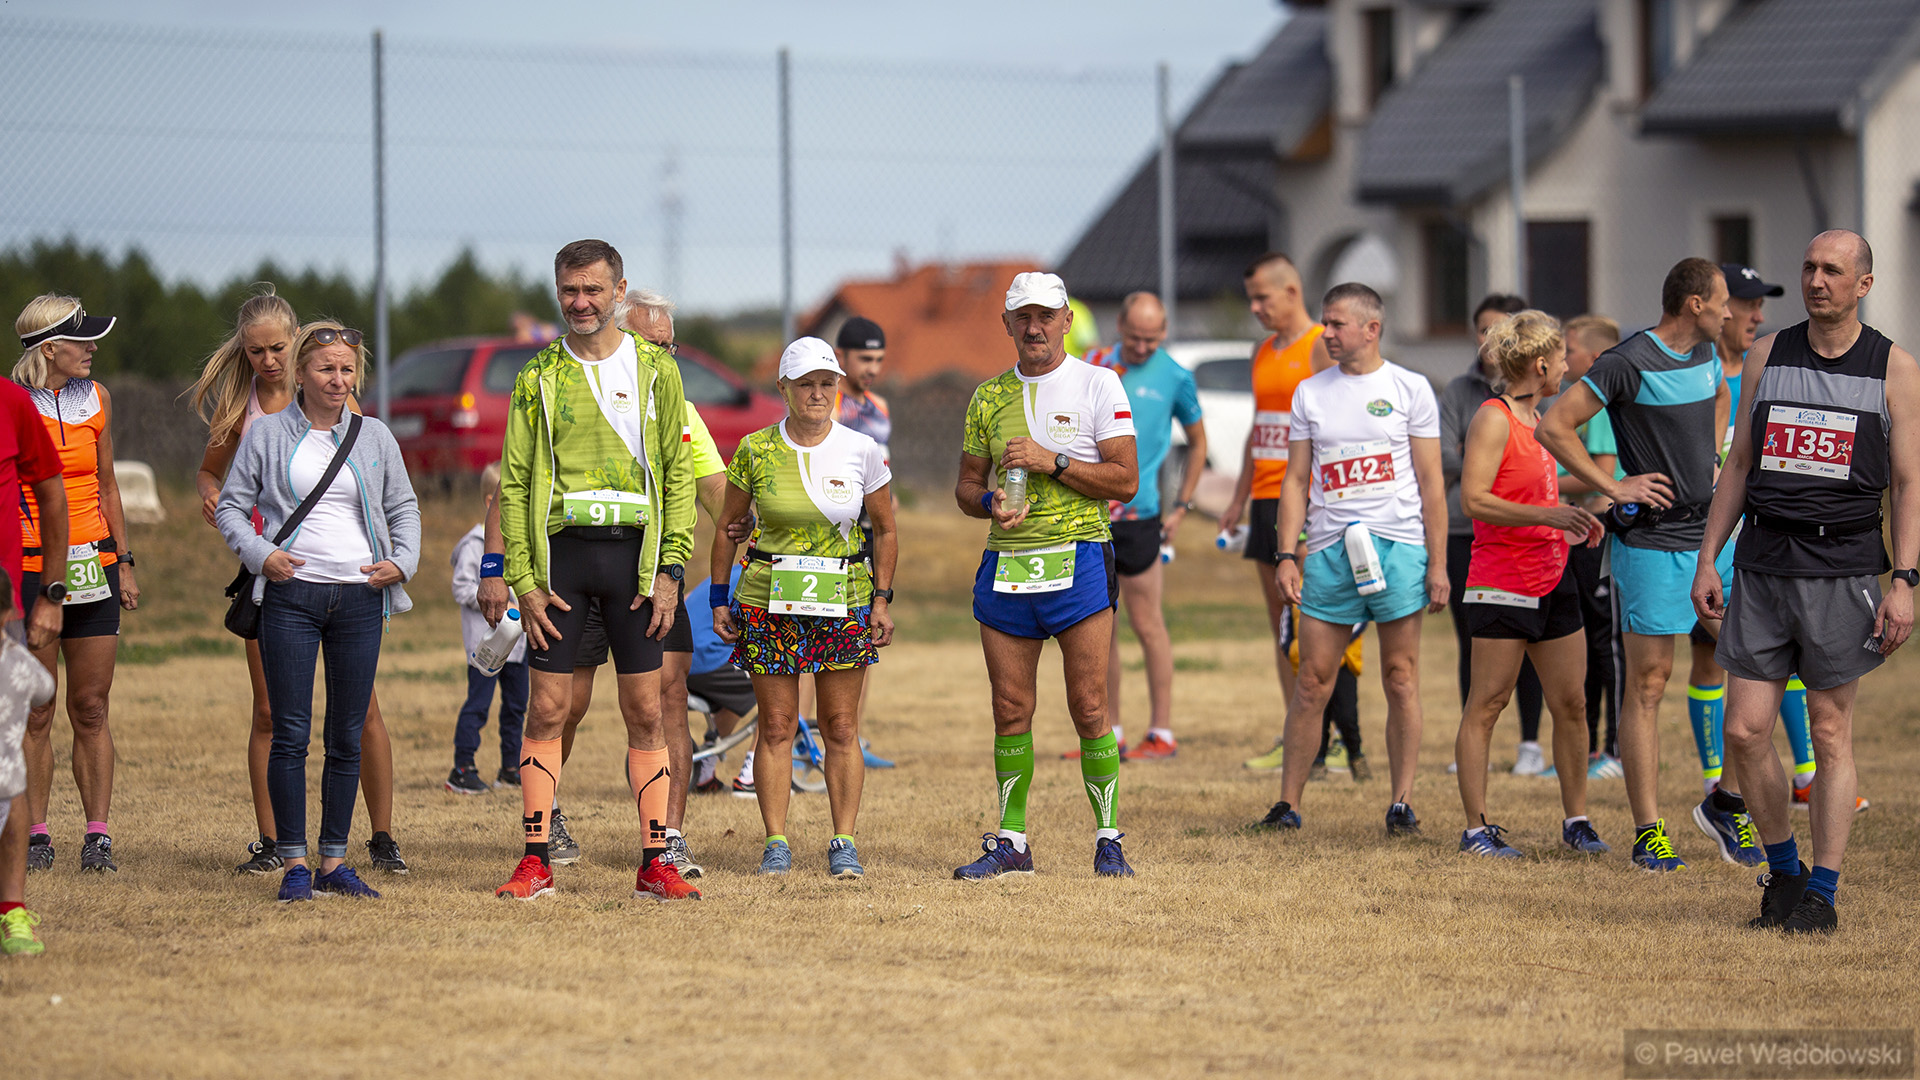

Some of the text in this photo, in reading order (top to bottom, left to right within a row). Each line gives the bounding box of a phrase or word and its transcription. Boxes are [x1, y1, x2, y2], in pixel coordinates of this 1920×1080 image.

[1260, 427, 1286, 447] 122
[1784, 428, 1836, 458] 135
[1334, 458, 1380, 485] 142
[589, 503, 620, 526] 91
[70, 561, 98, 586] 30
[1029, 557, 1044, 579] 3
[802, 574, 818, 598] 2
